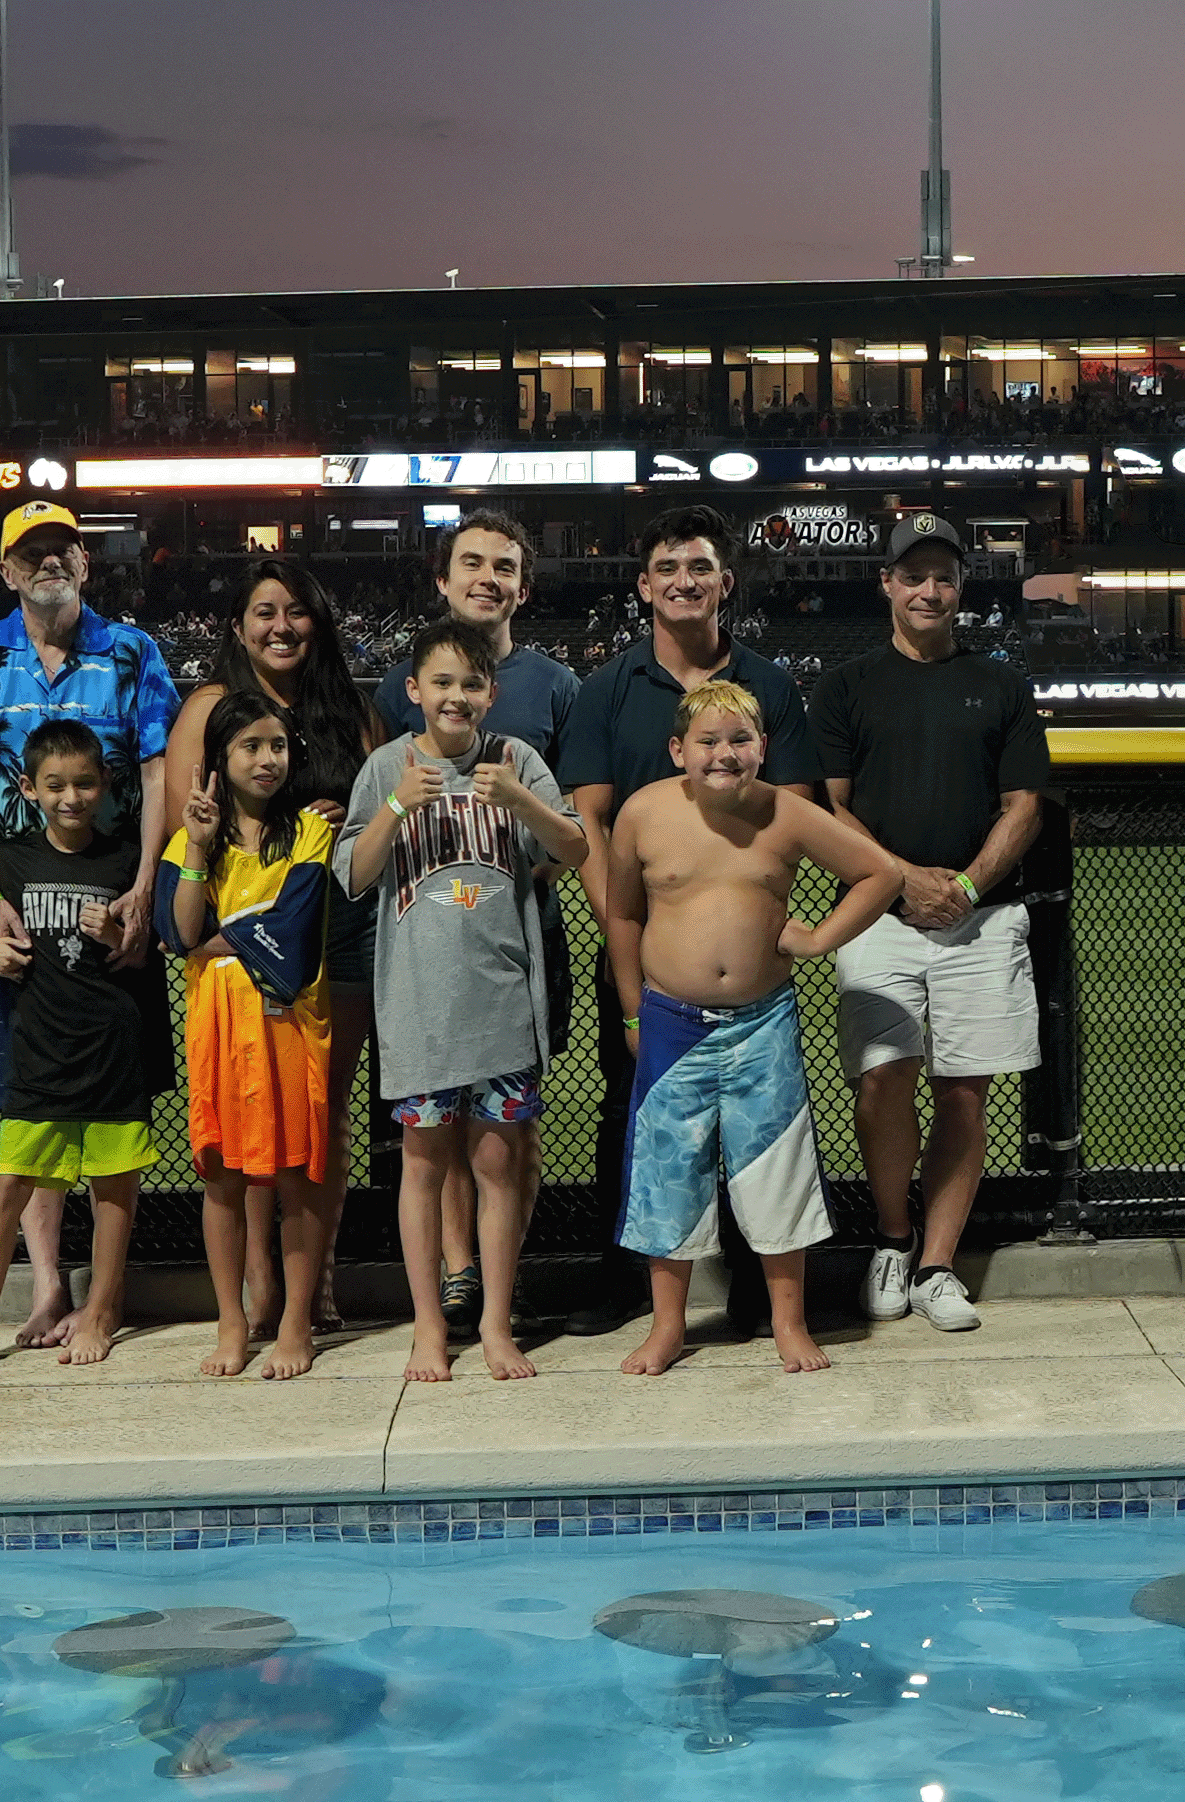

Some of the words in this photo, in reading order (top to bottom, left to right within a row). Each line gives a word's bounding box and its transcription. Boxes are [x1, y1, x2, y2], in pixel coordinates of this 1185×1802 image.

[805, 457, 851, 472] LAS
[852, 456, 930, 471] VEGAS
[783, 506, 806, 518] LAS
[806, 505, 847, 518] VEGAS
[1033, 684, 1079, 699] LAS
[1079, 683, 1160, 699] VEGAS
[449, 878, 483, 911] LV
